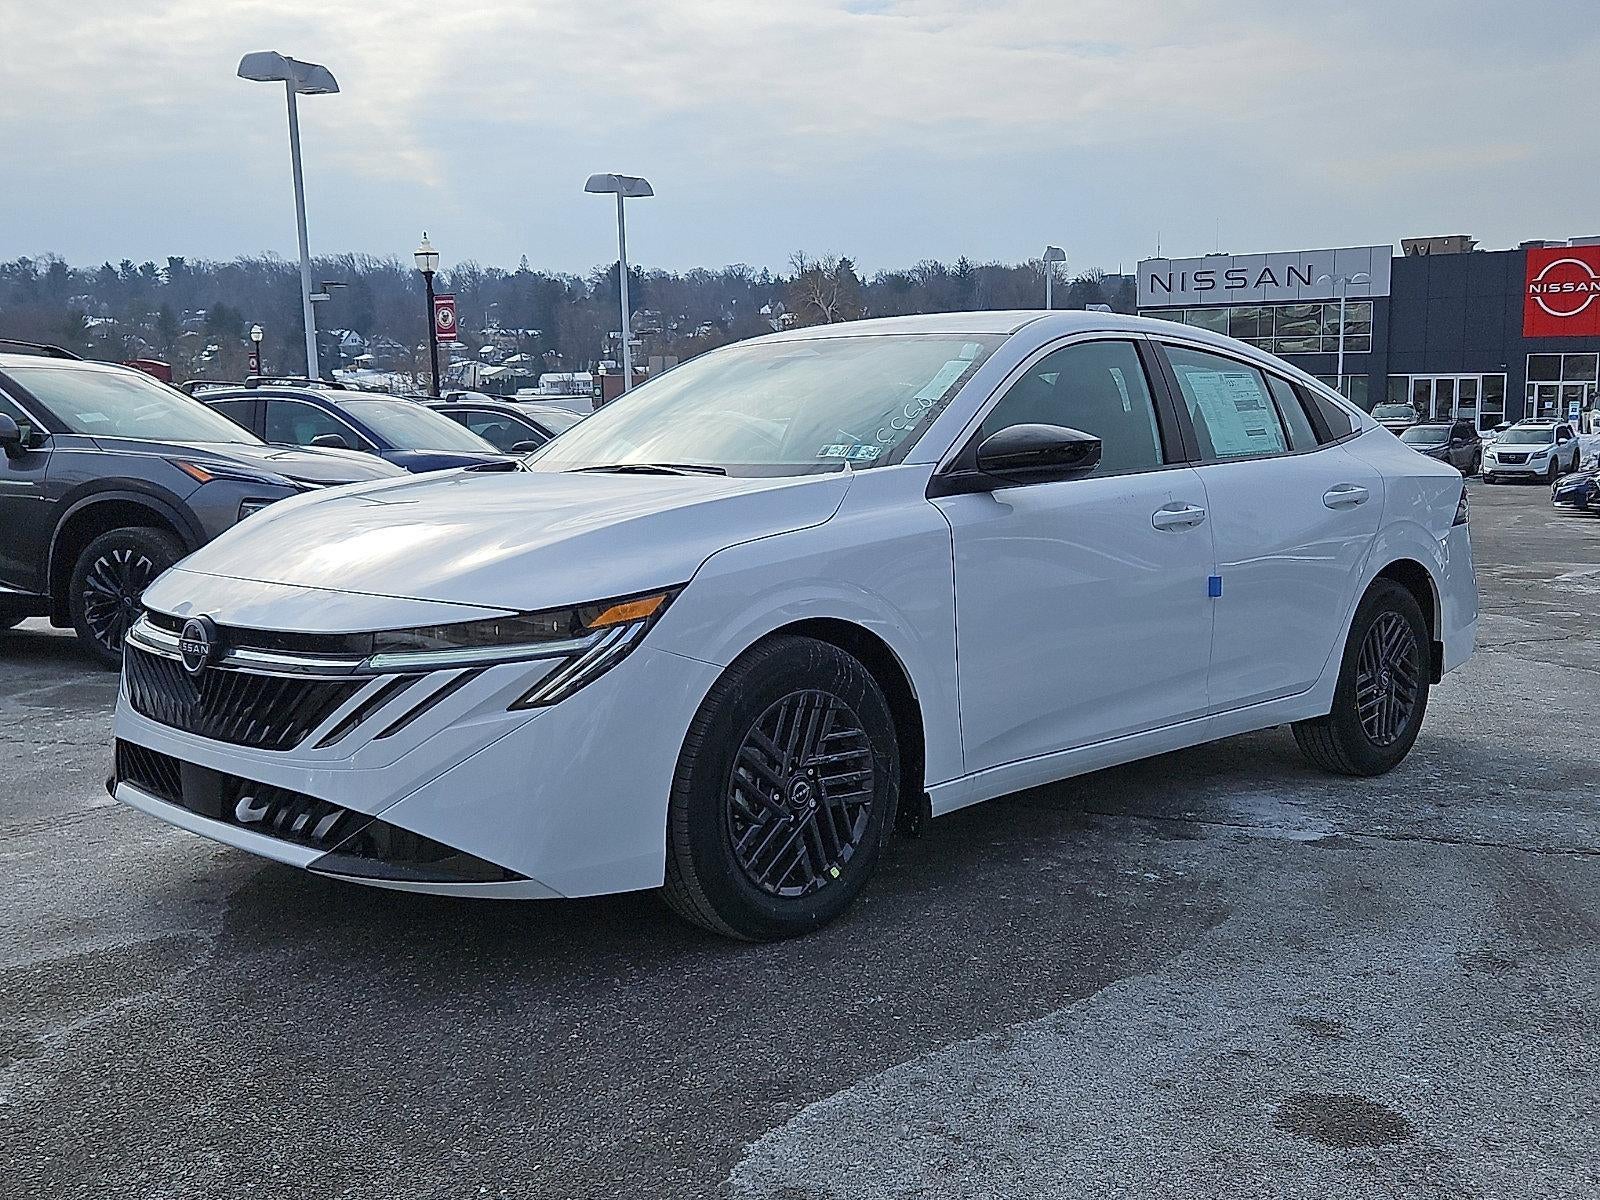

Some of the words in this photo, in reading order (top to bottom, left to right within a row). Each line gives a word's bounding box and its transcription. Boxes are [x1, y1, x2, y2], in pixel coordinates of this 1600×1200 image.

[1150, 264, 1313, 293] NISSAN
[1529, 281, 1600, 294] NISSAN
[180, 642, 209, 655] SSAN
